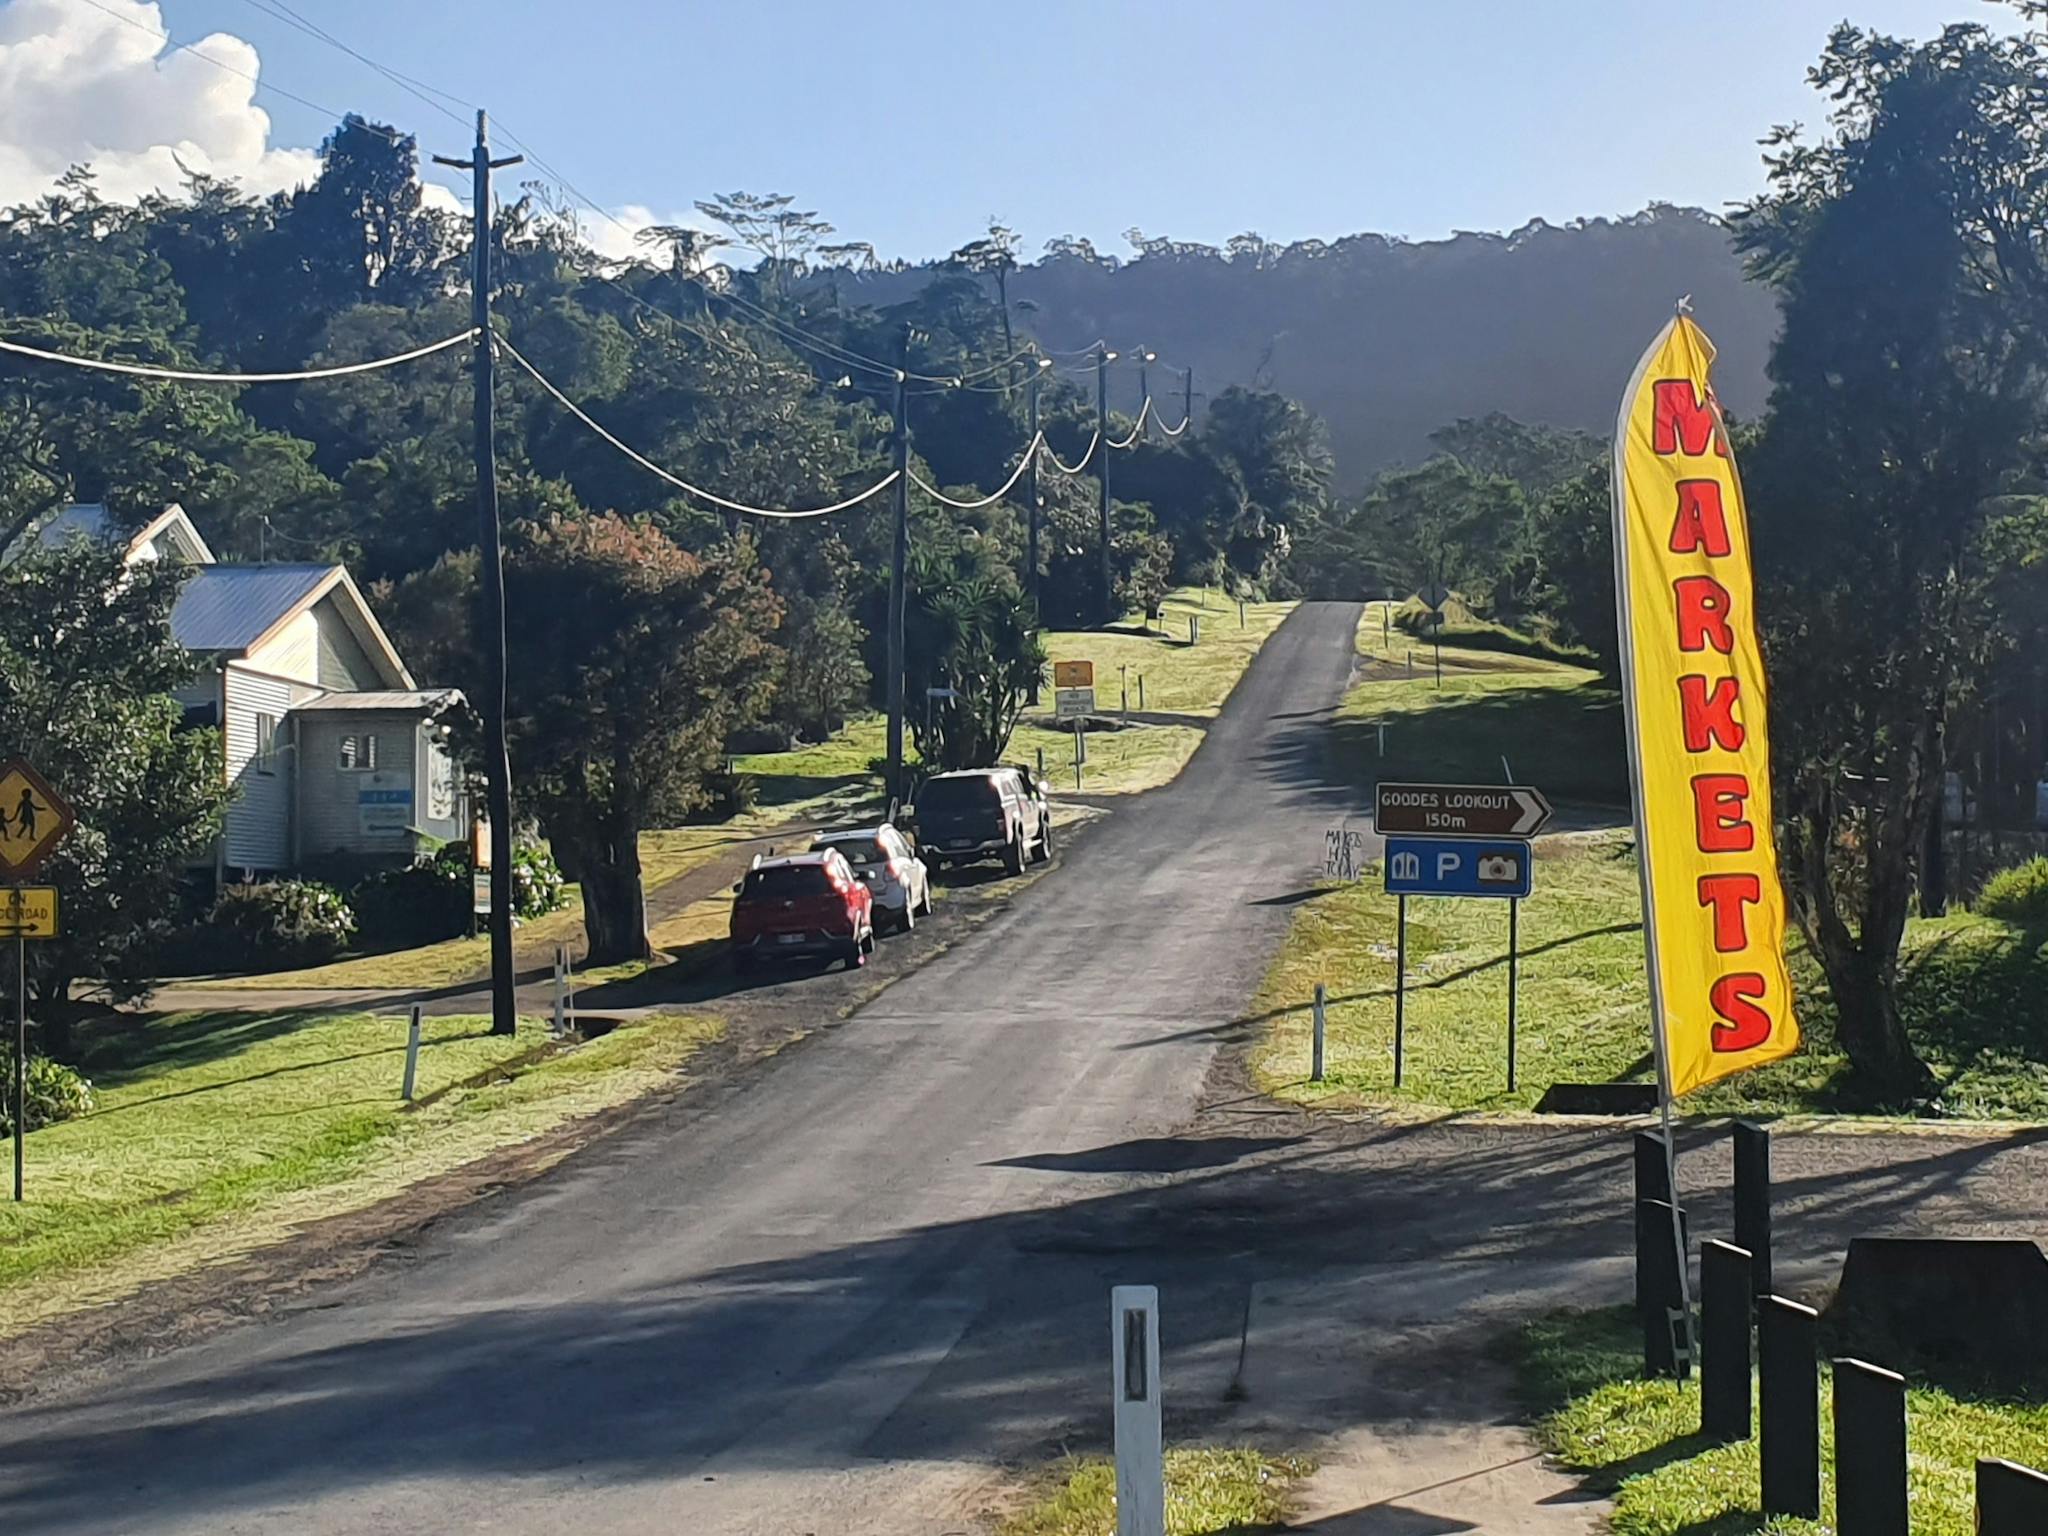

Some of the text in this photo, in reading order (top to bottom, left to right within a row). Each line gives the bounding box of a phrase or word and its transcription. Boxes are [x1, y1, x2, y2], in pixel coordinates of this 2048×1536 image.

[1652, 378, 1771, 1053] MARKETS
[1381, 791, 1510, 810] GOODES LOOKOUT
[1424, 812, 1466, 828] 150m
[1437, 852, 1461, 880] P
